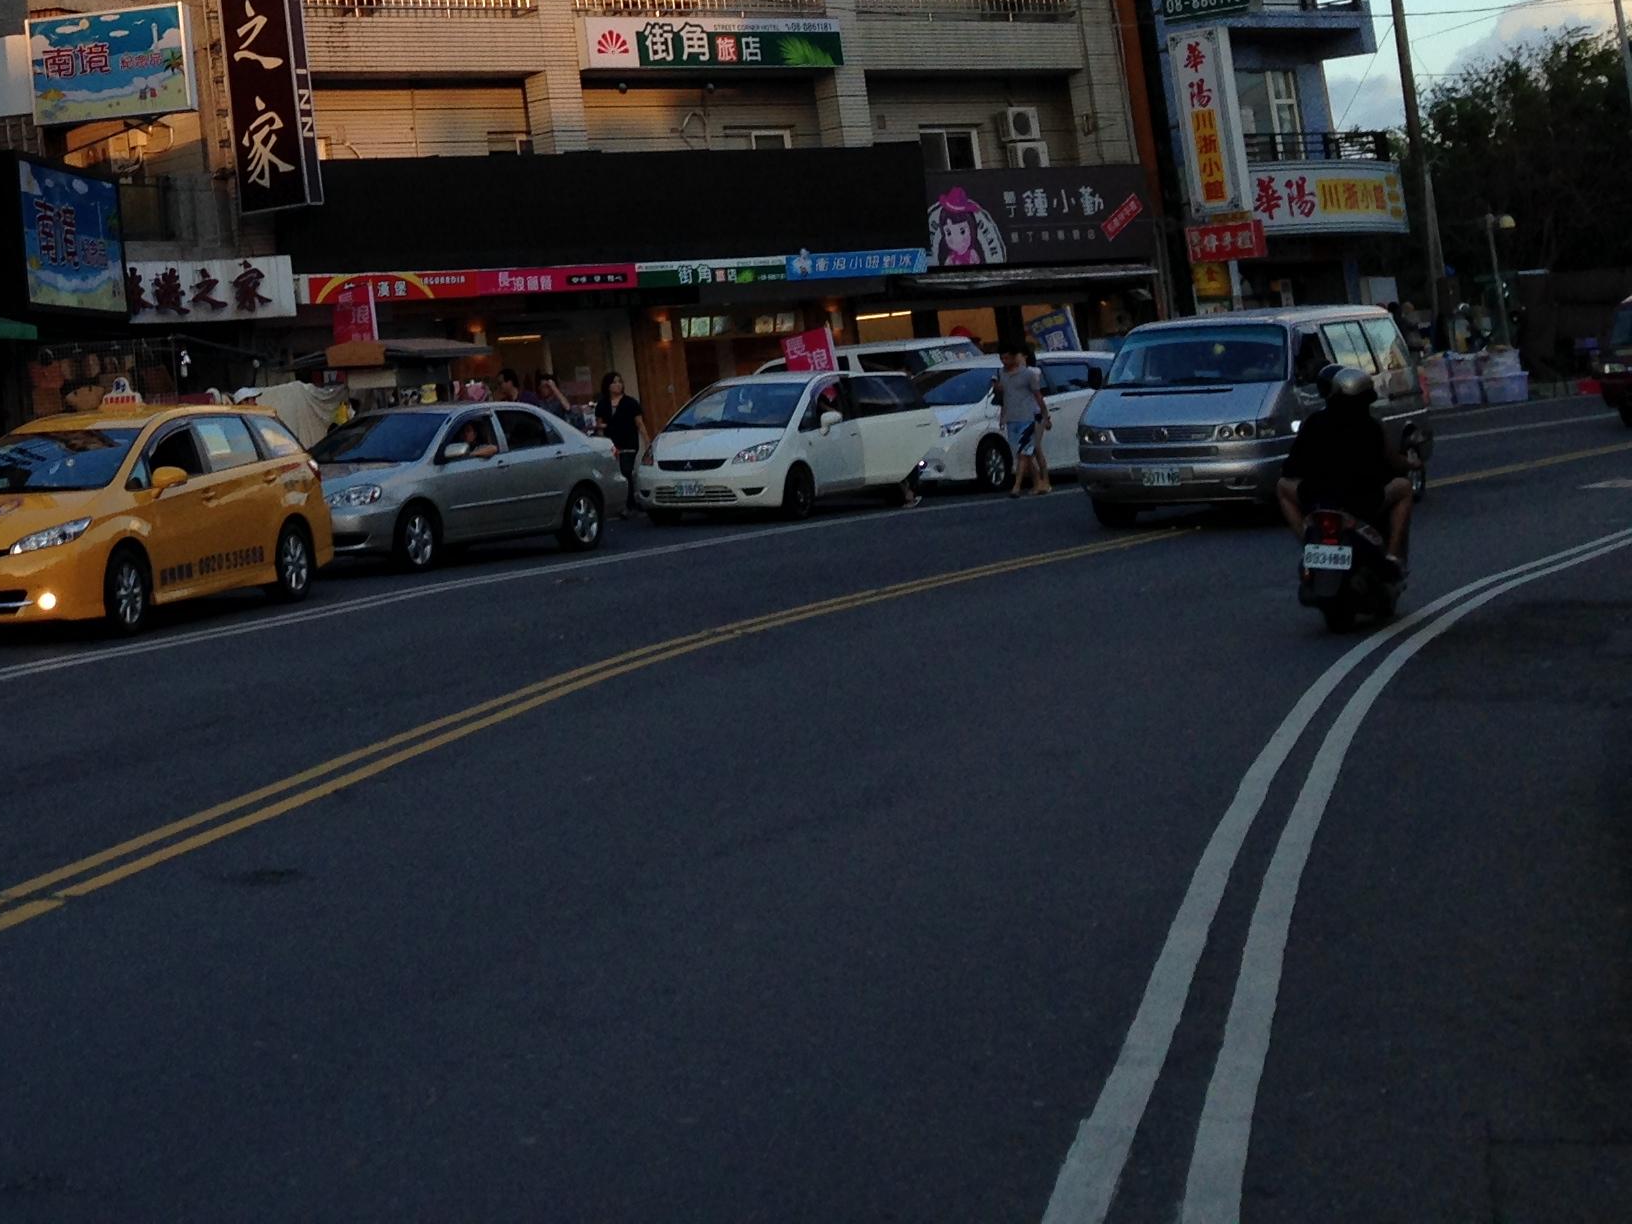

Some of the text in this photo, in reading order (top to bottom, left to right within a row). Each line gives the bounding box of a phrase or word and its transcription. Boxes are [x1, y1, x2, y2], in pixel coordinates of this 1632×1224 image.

[644, 20, 762, 63] 街角旅店
[295, 68, 314, 138] INN
